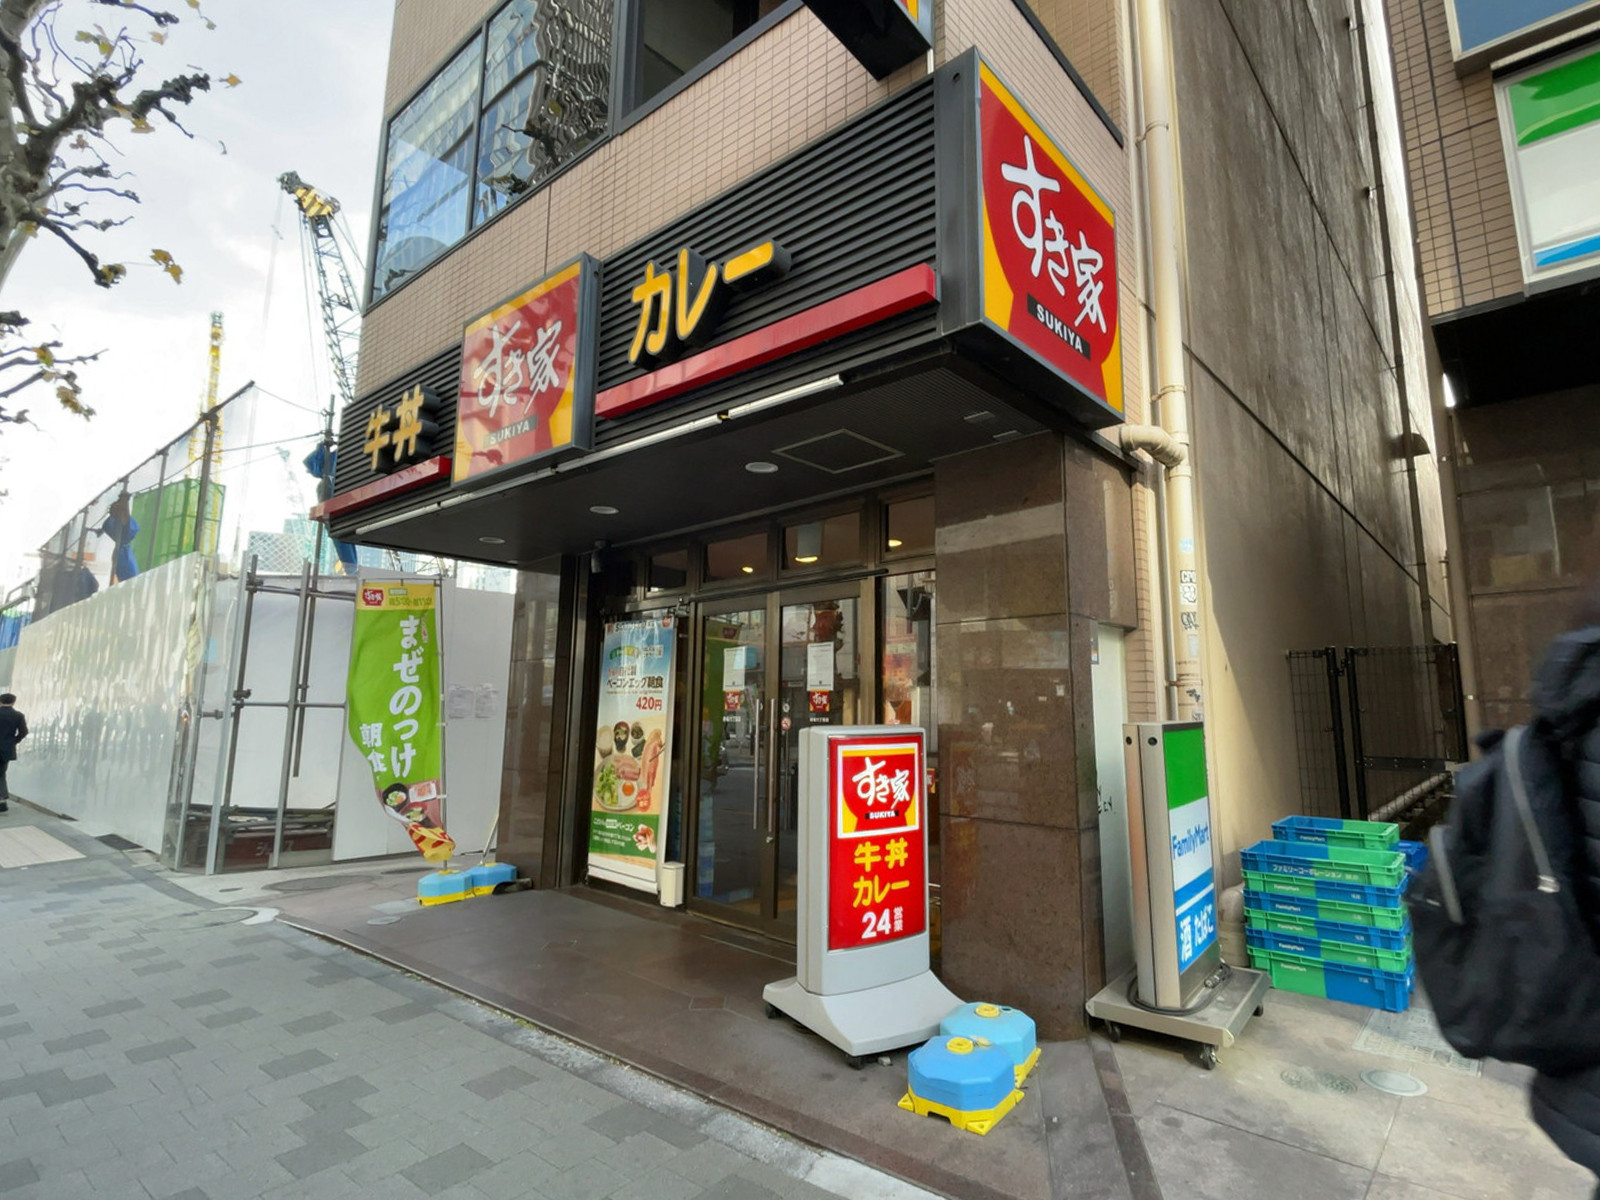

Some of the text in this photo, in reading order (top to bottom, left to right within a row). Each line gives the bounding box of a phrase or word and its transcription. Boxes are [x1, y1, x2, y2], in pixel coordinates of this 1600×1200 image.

[1001, 133, 1107, 334] すき家
[629, 240, 776, 365] カレー
[1036, 303, 1084, 355] SUKIYA
[472, 320, 563, 419] すき家
[363, 384, 426, 473] 牛丼
[488, 420, 532, 446] SUKIYA
[389, 614, 424, 779] まぜのっけ
[636, 697, 662, 710] 420円
[852, 756, 911, 810] すき家
[868, 809, 898, 821] SUKIYA
[853, 837, 909, 872] 牛丼
[1172, 823, 1210, 860] FamilyMart
[852, 874, 911, 909] カレー
[861, 908, 892, 940] 24
[1180, 904, 1215, 962] 酒 たばこ
